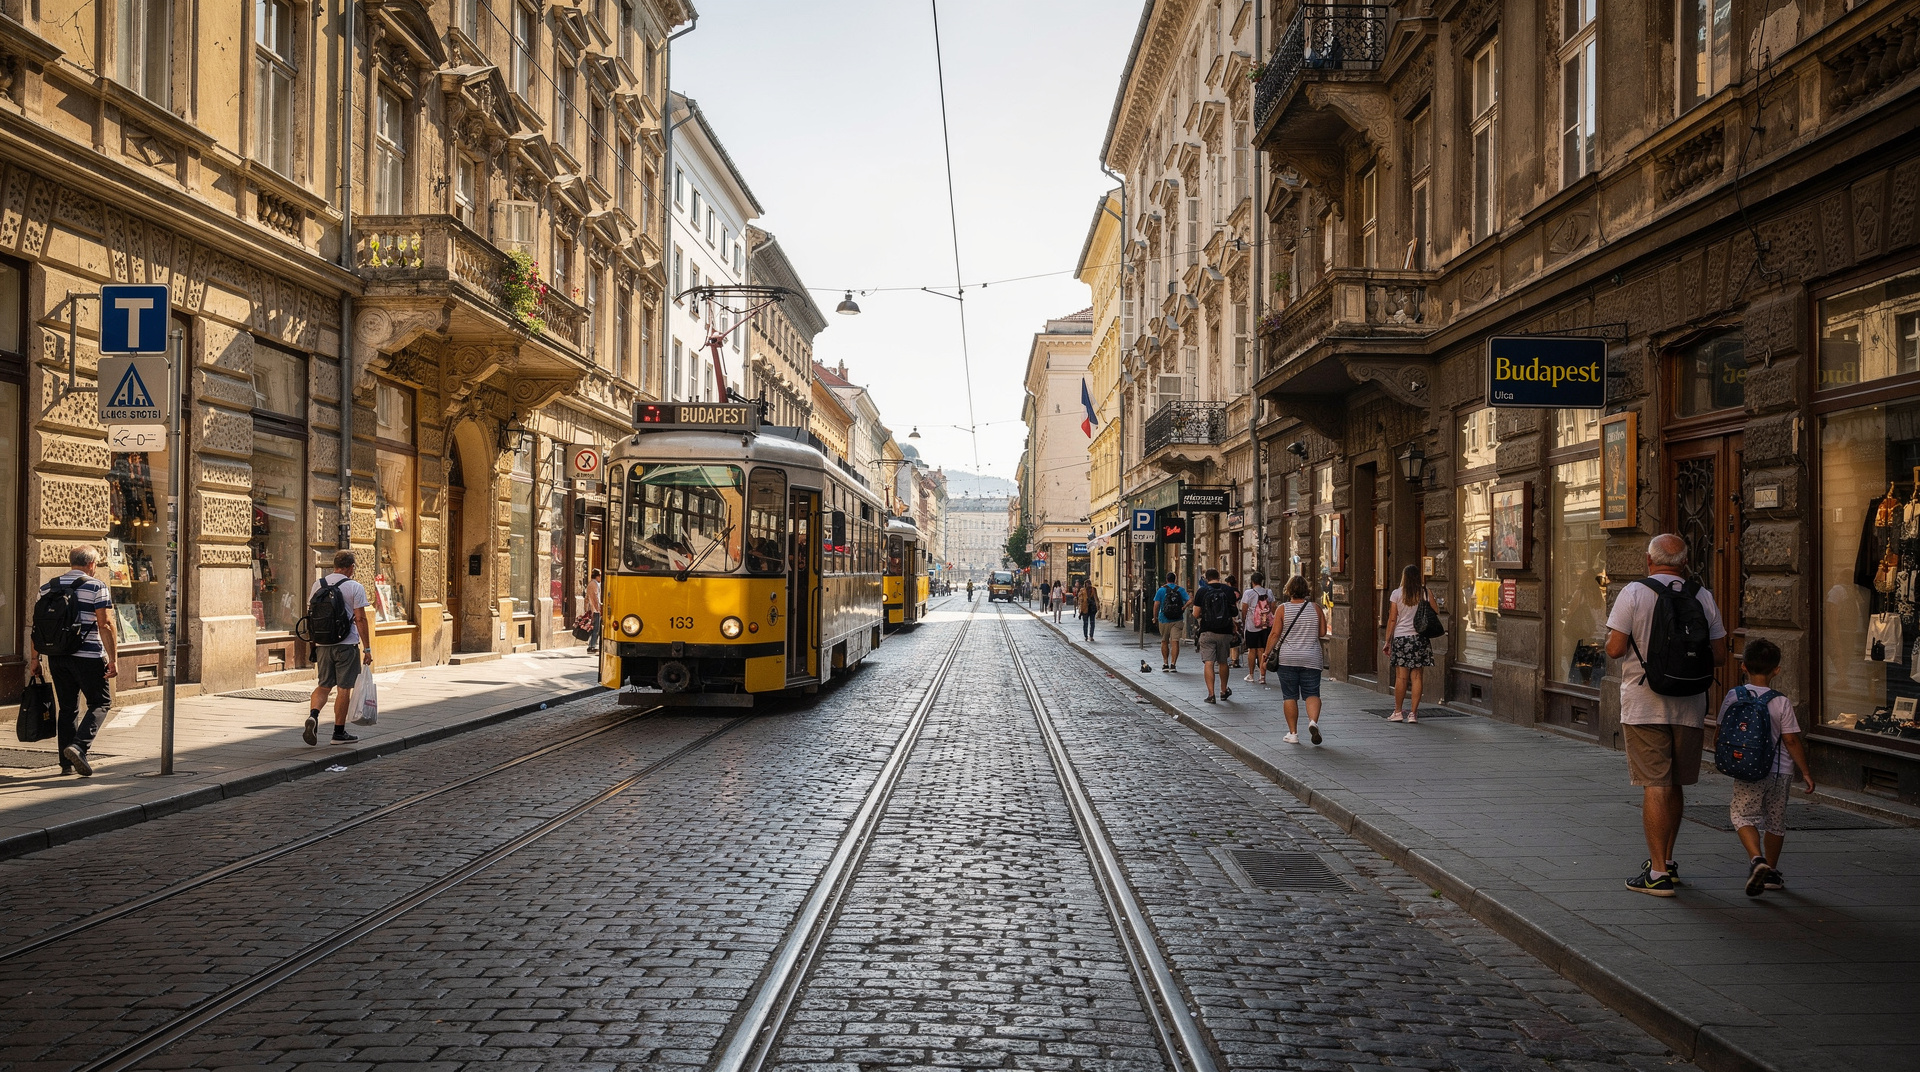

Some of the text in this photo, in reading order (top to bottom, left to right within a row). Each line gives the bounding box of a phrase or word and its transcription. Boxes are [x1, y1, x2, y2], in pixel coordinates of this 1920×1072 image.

[115, 298, 153, 348] T
[1495, 357, 1600, 388] Budapest
[680, 406, 747, 424] BUDAPEST
[1136, 512, 1151, 529] P
[669, 616, 694, 629] 163
